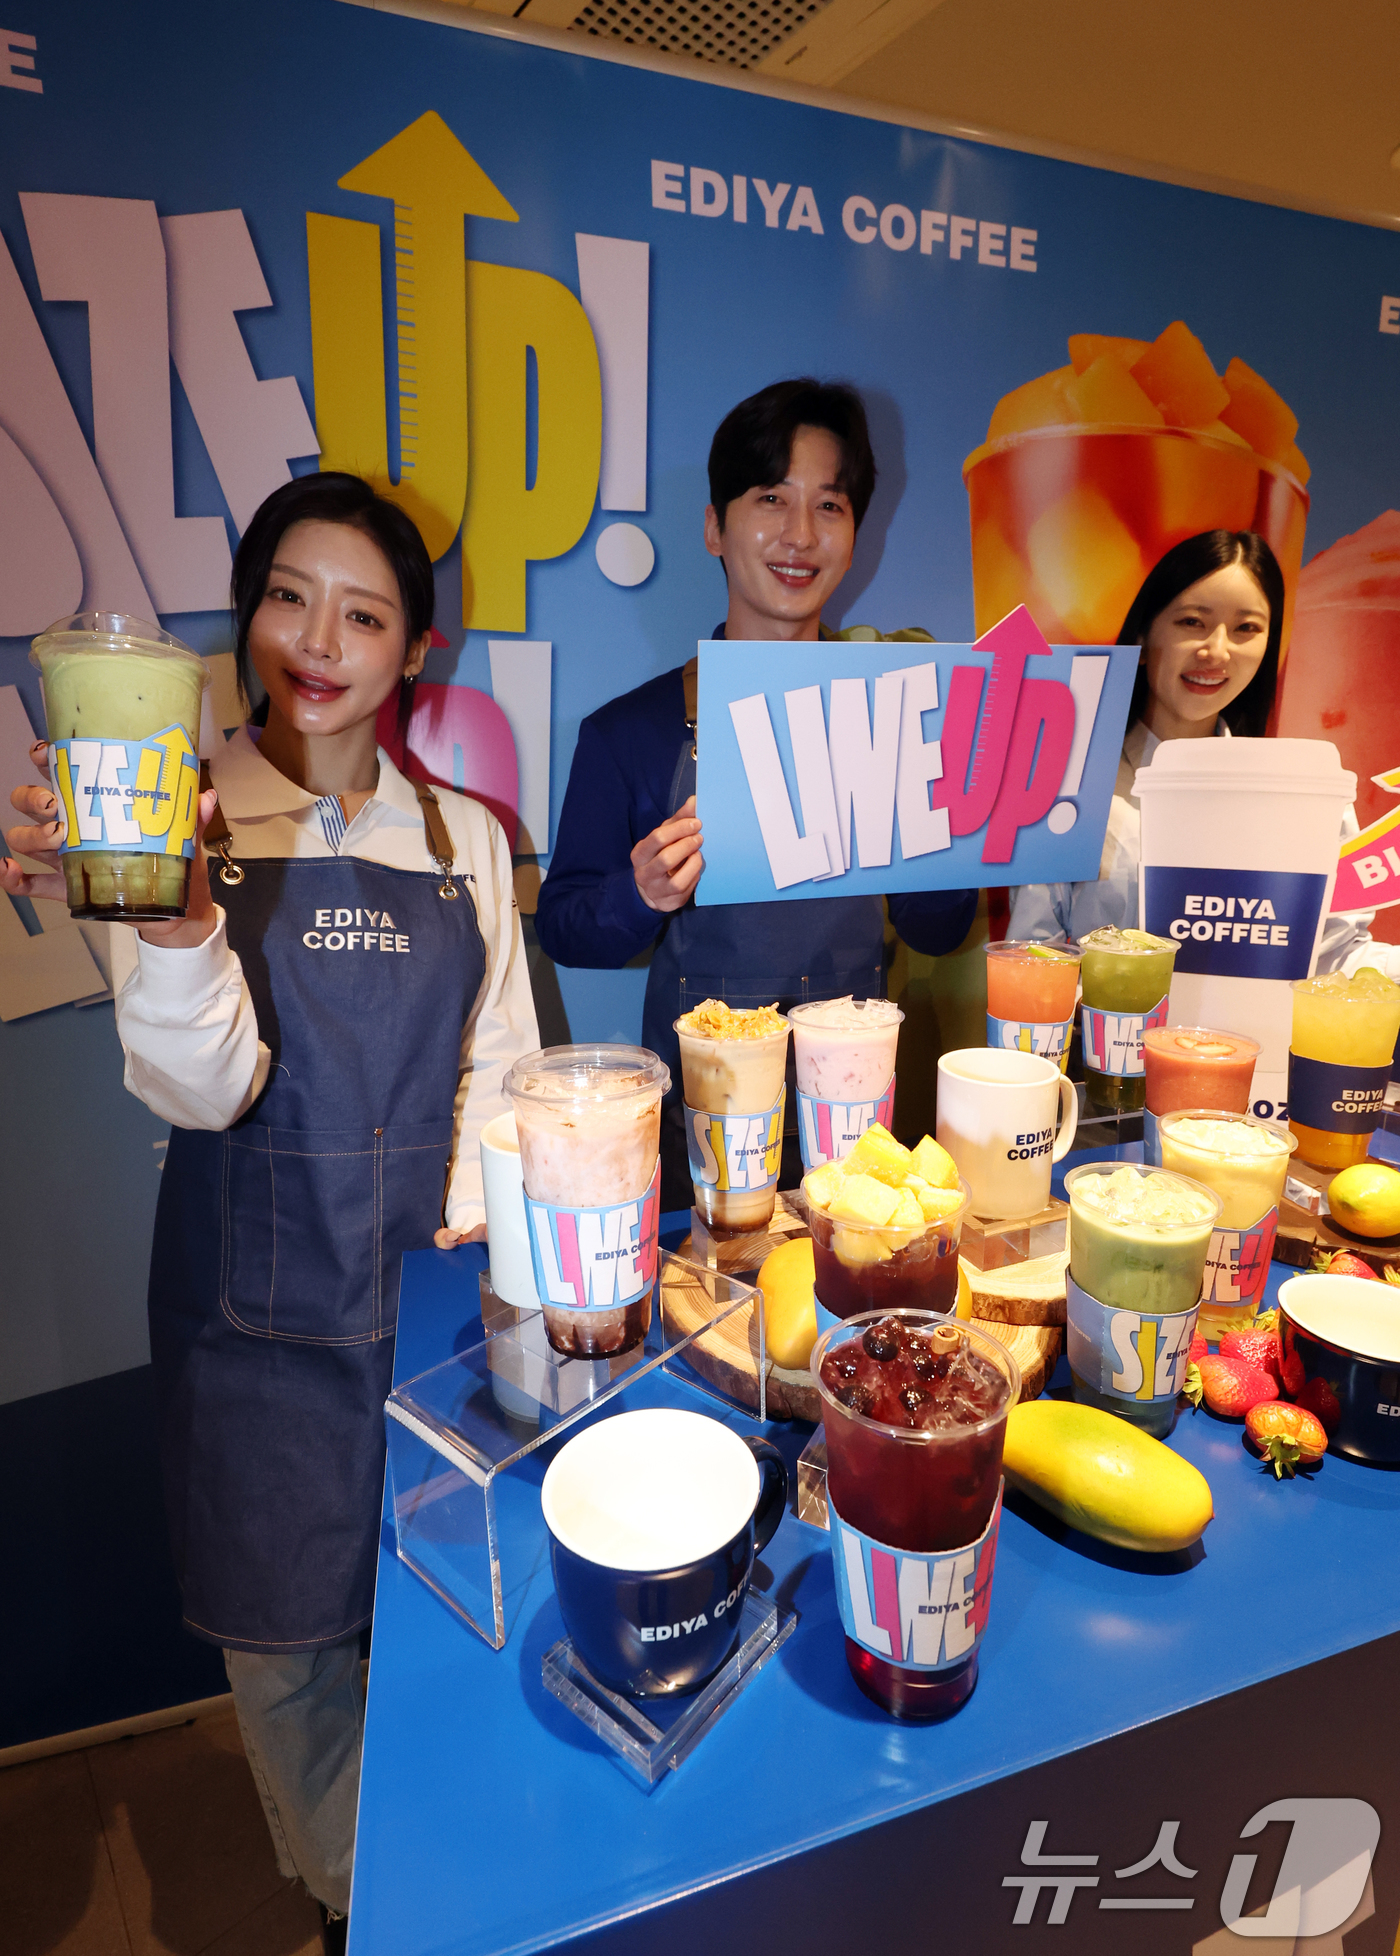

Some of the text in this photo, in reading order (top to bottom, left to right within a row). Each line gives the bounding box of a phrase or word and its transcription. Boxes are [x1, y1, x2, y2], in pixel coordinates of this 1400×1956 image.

[651, 159, 1038, 273] EDIYA COFFEE
[83, 786, 171, 801] EDIYA COFFEE
[315, 908, 397, 930] EDIYA
[1184, 895, 1277, 921] EDIYA
[302, 931, 411, 953] COFFEE
[1169, 918, 1290, 947] COFFEE
[1342, 1089, 1384, 1101] EDIYA
[1016, 1127, 1052, 1146] EDIYA
[1007, 1139, 1054, 1161] COFFEE
[595, 1248, 629, 1261] EDIYA
[918, 1602, 960, 1615] EDIYA
[640, 1613, 709, 1642] EDIYA
